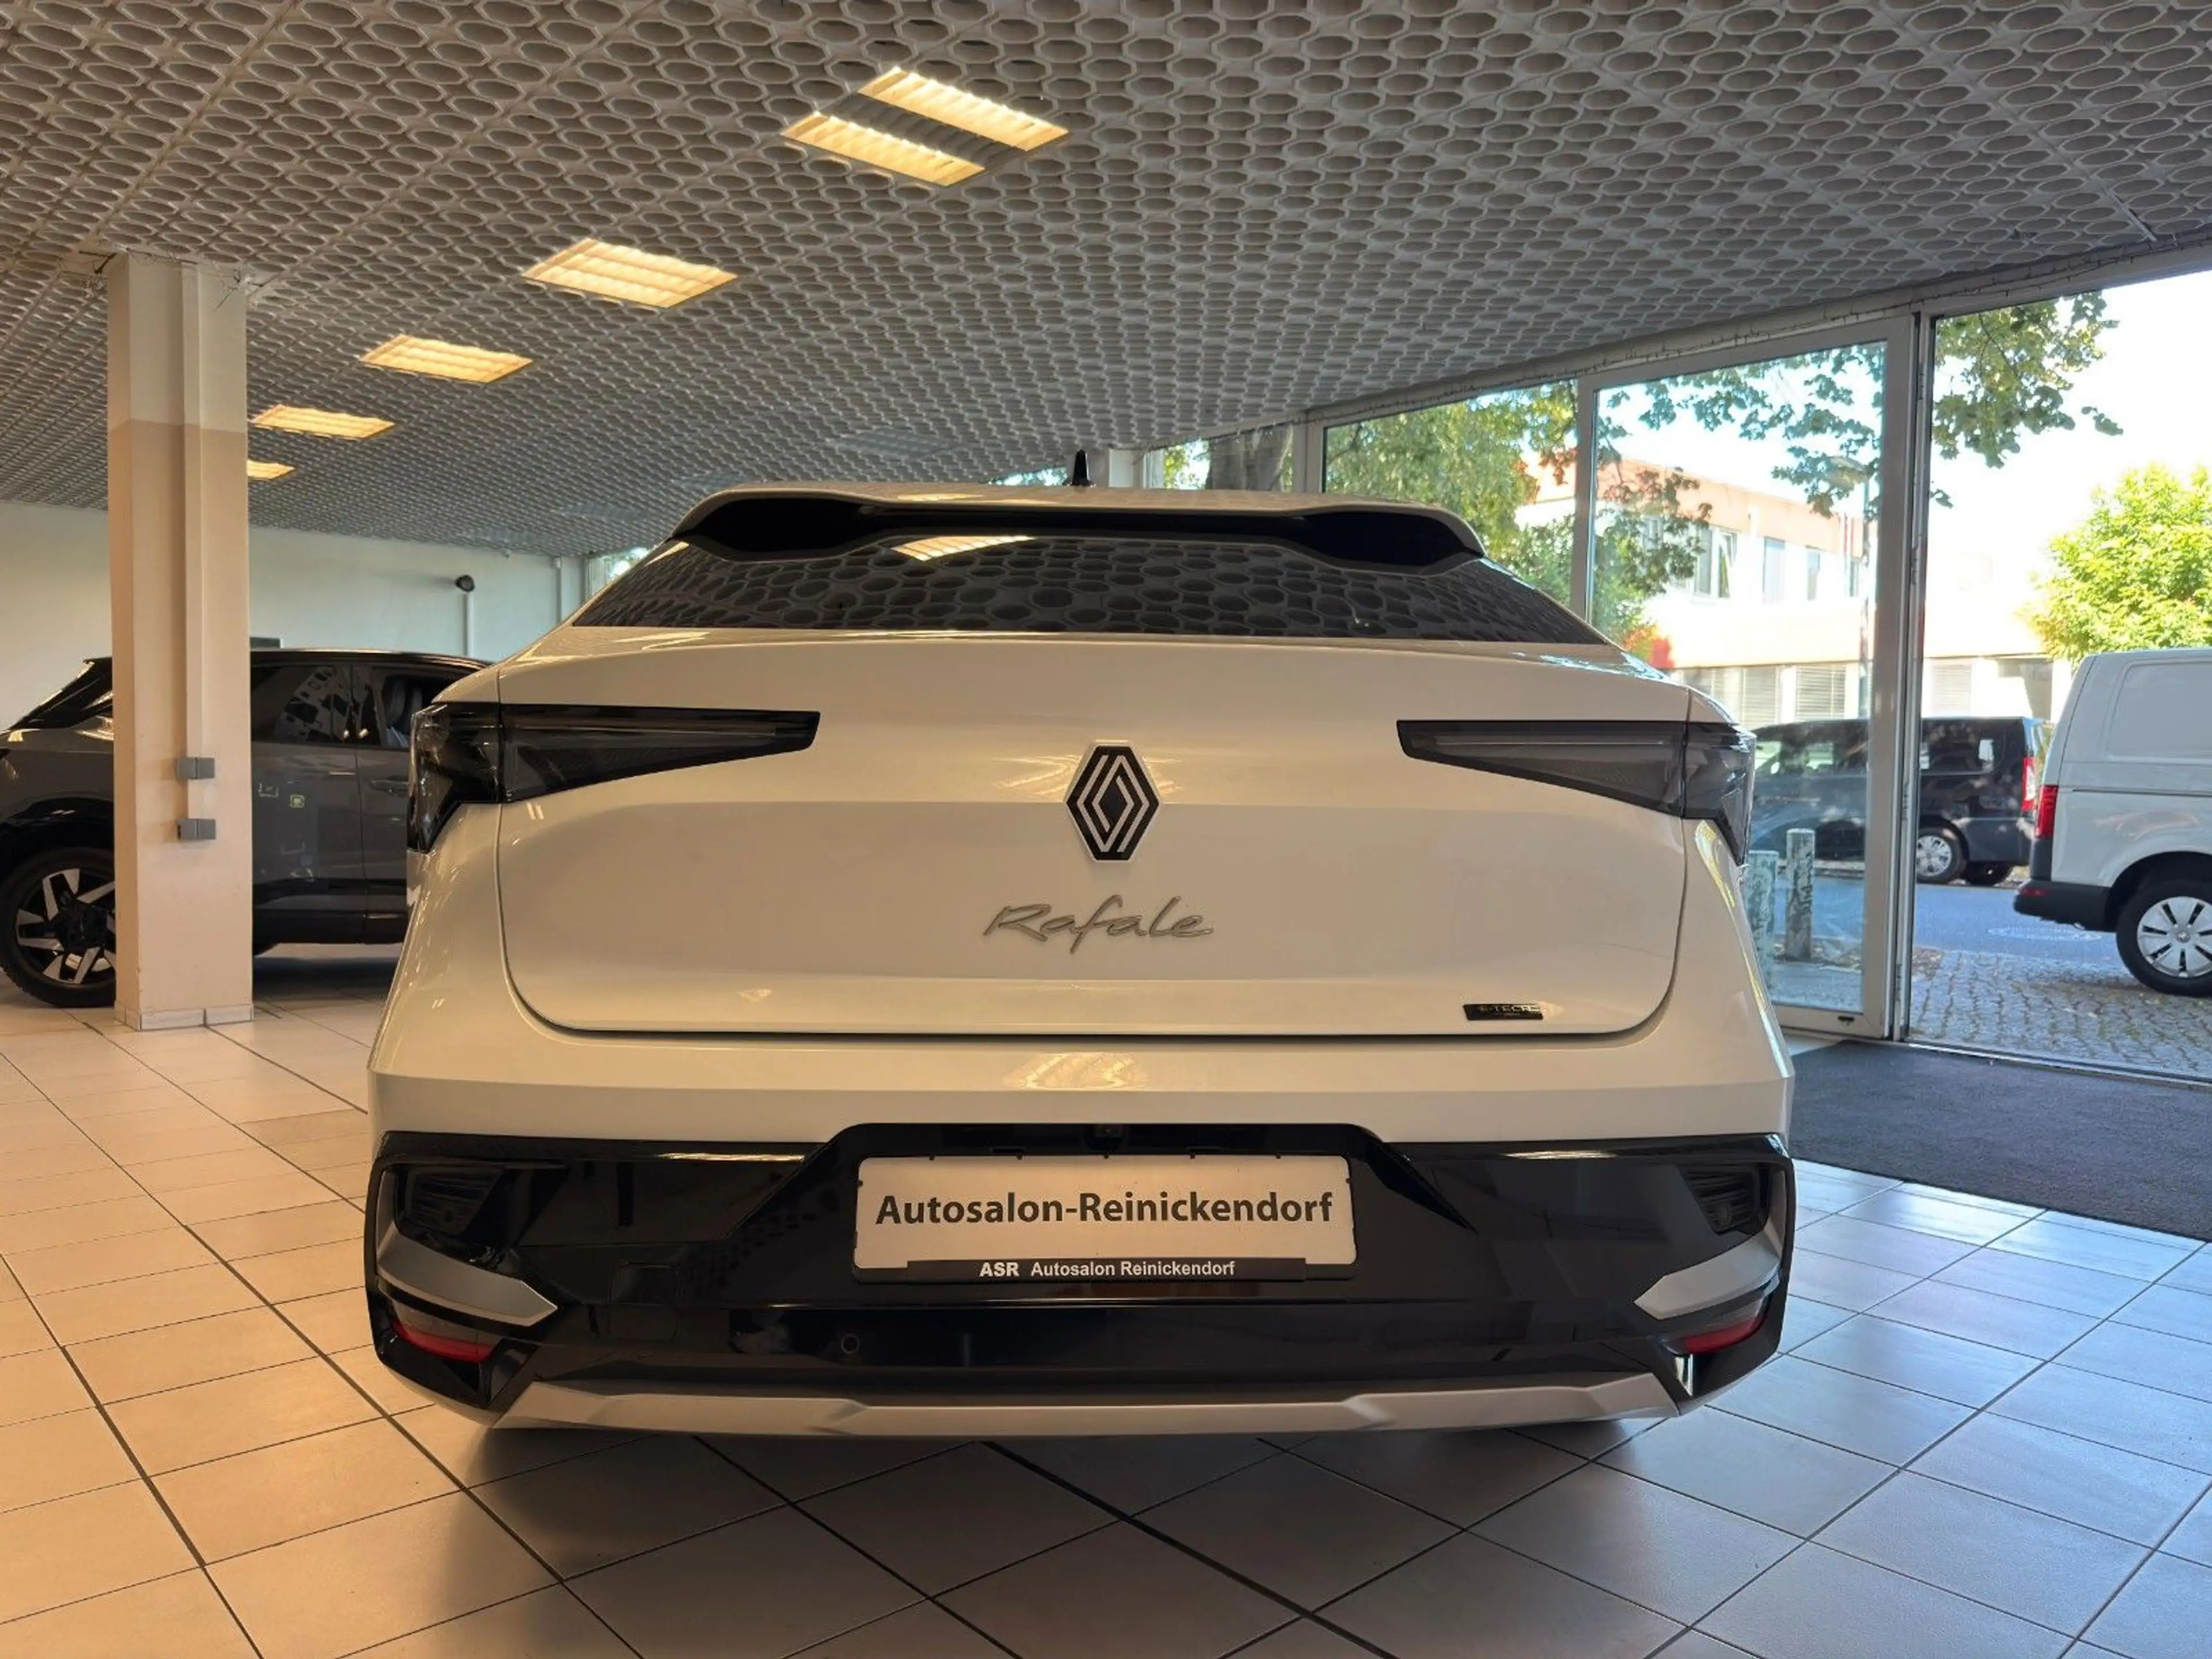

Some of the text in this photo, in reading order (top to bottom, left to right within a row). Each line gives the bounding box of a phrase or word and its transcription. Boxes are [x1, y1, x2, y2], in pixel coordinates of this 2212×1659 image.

[983, 894, 1214, 955] Rafale
[875, 1191, 1333, 1225] Autosalon-Reinickendorf
[979, 1260, 1236, 1277] ASR Autosalon Reinickendorf
